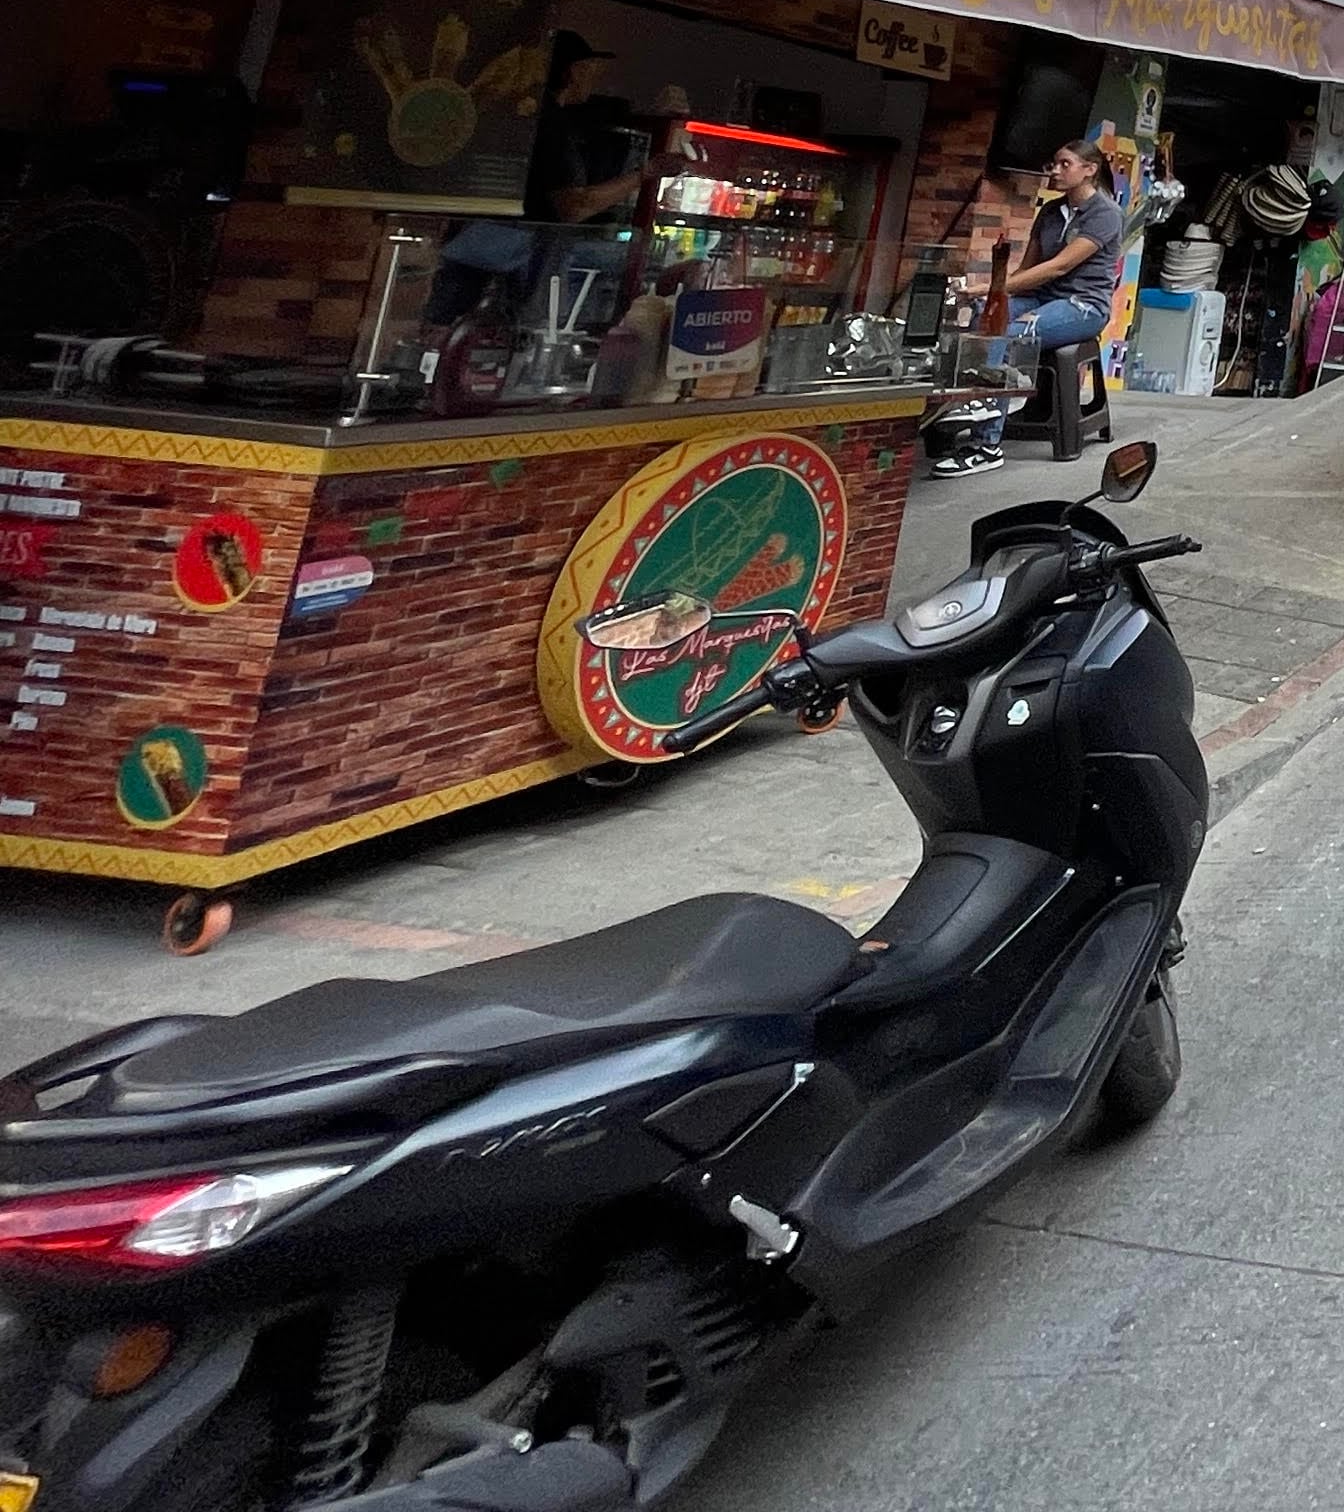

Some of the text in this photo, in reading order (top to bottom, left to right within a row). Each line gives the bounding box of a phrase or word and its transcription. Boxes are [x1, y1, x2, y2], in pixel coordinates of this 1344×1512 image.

[864, 18, 920, 60] Coffee
[682, 309, 753, 328] ABIERTO
[621, 649, 669, 681] Las
